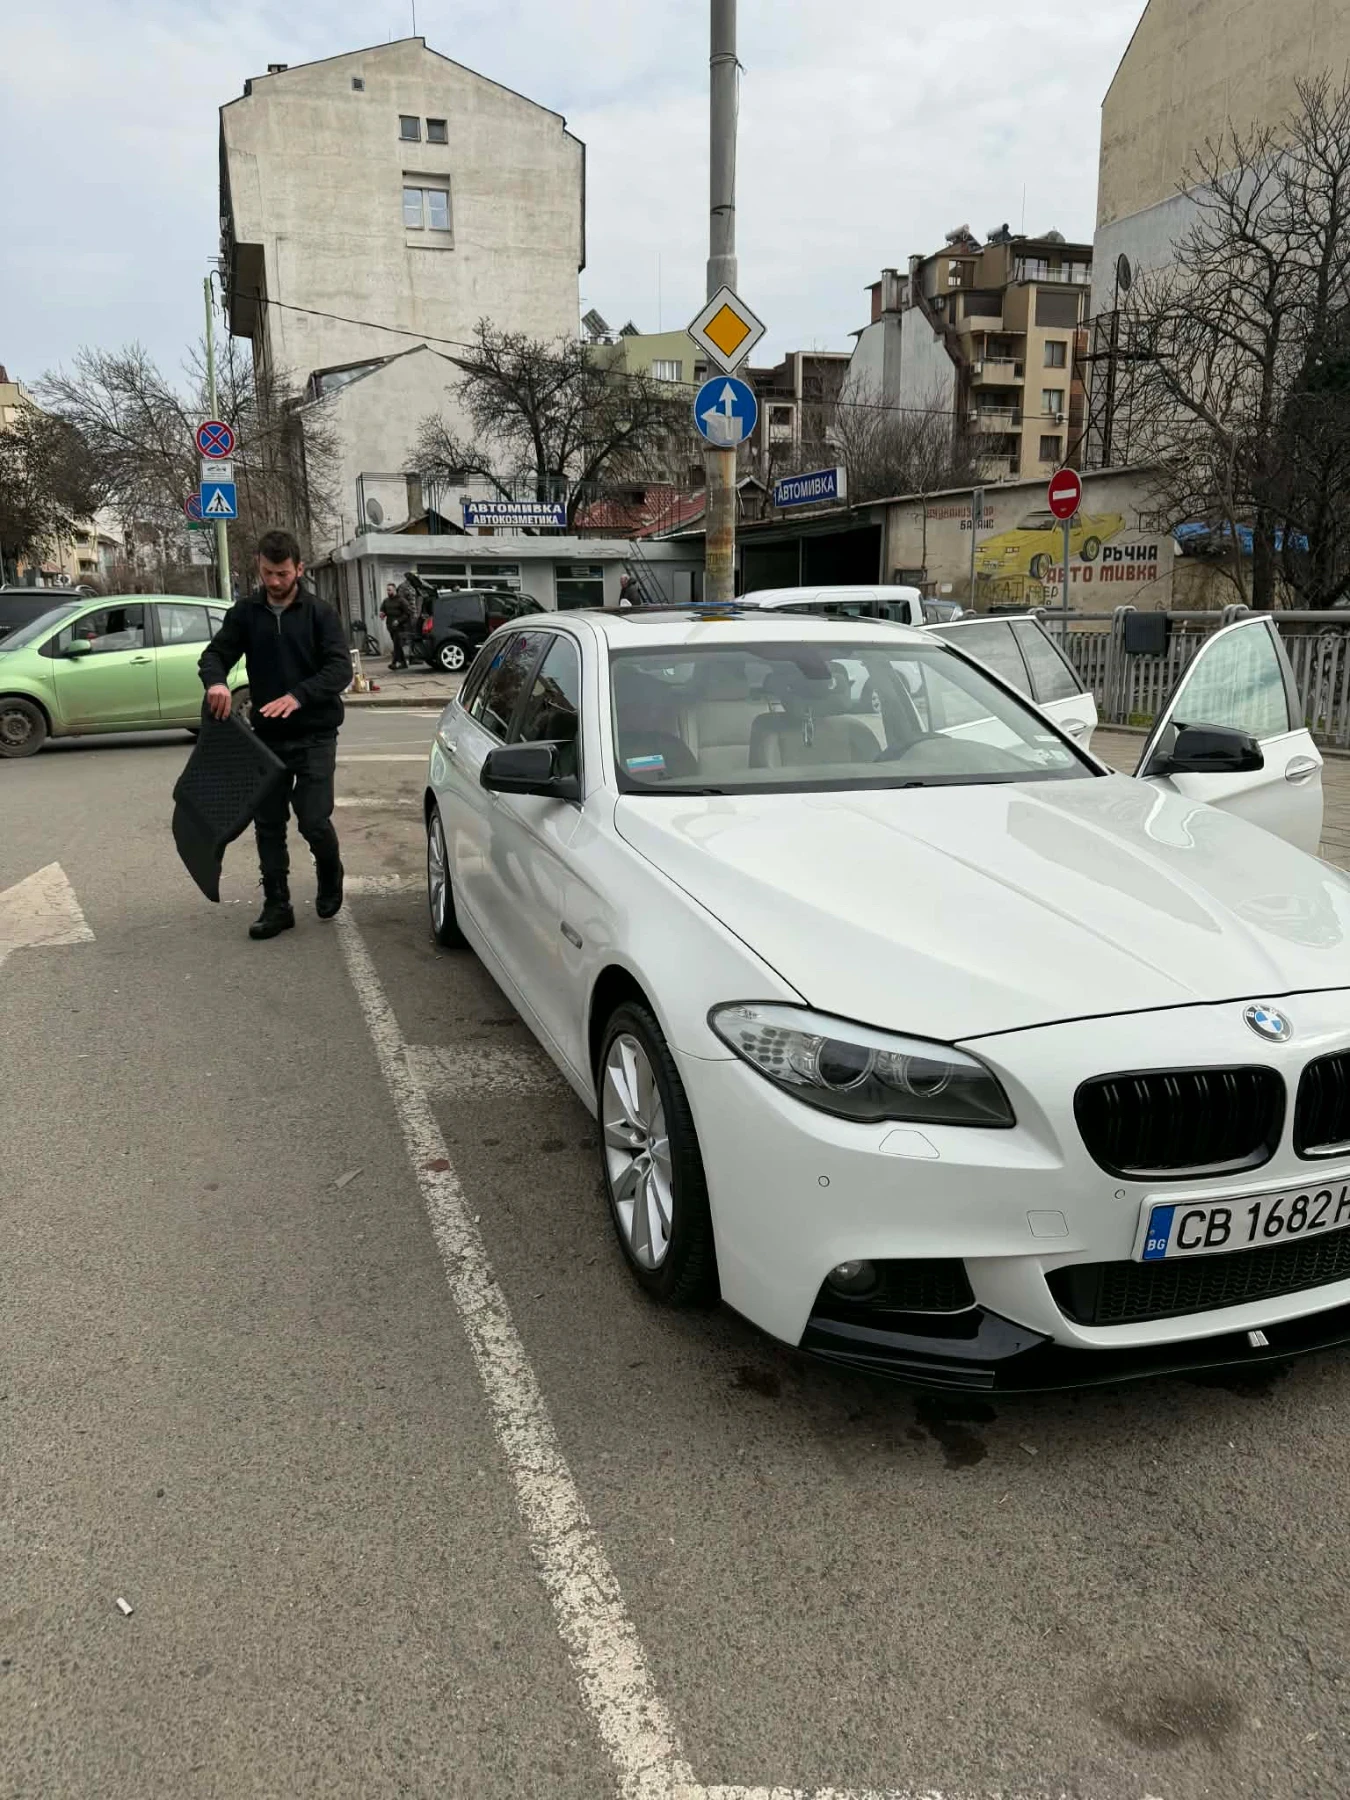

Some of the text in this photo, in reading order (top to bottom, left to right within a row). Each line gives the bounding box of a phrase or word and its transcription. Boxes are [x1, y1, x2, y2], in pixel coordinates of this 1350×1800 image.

[778, 475, 835, 502] АВТОМИВКА
[468, 503, 562, 514] АВТОМИВКА
[473, 514, 559, 525] АВТОКОЗМЕТИКА
[1102, 545, 1158, 562] РЪЧНА
[1100, 564, 1157, 582] МИВКА
[1247, 1189, 1332, 1242] 1682
[1147, 1239, 1167, 1251] BG
